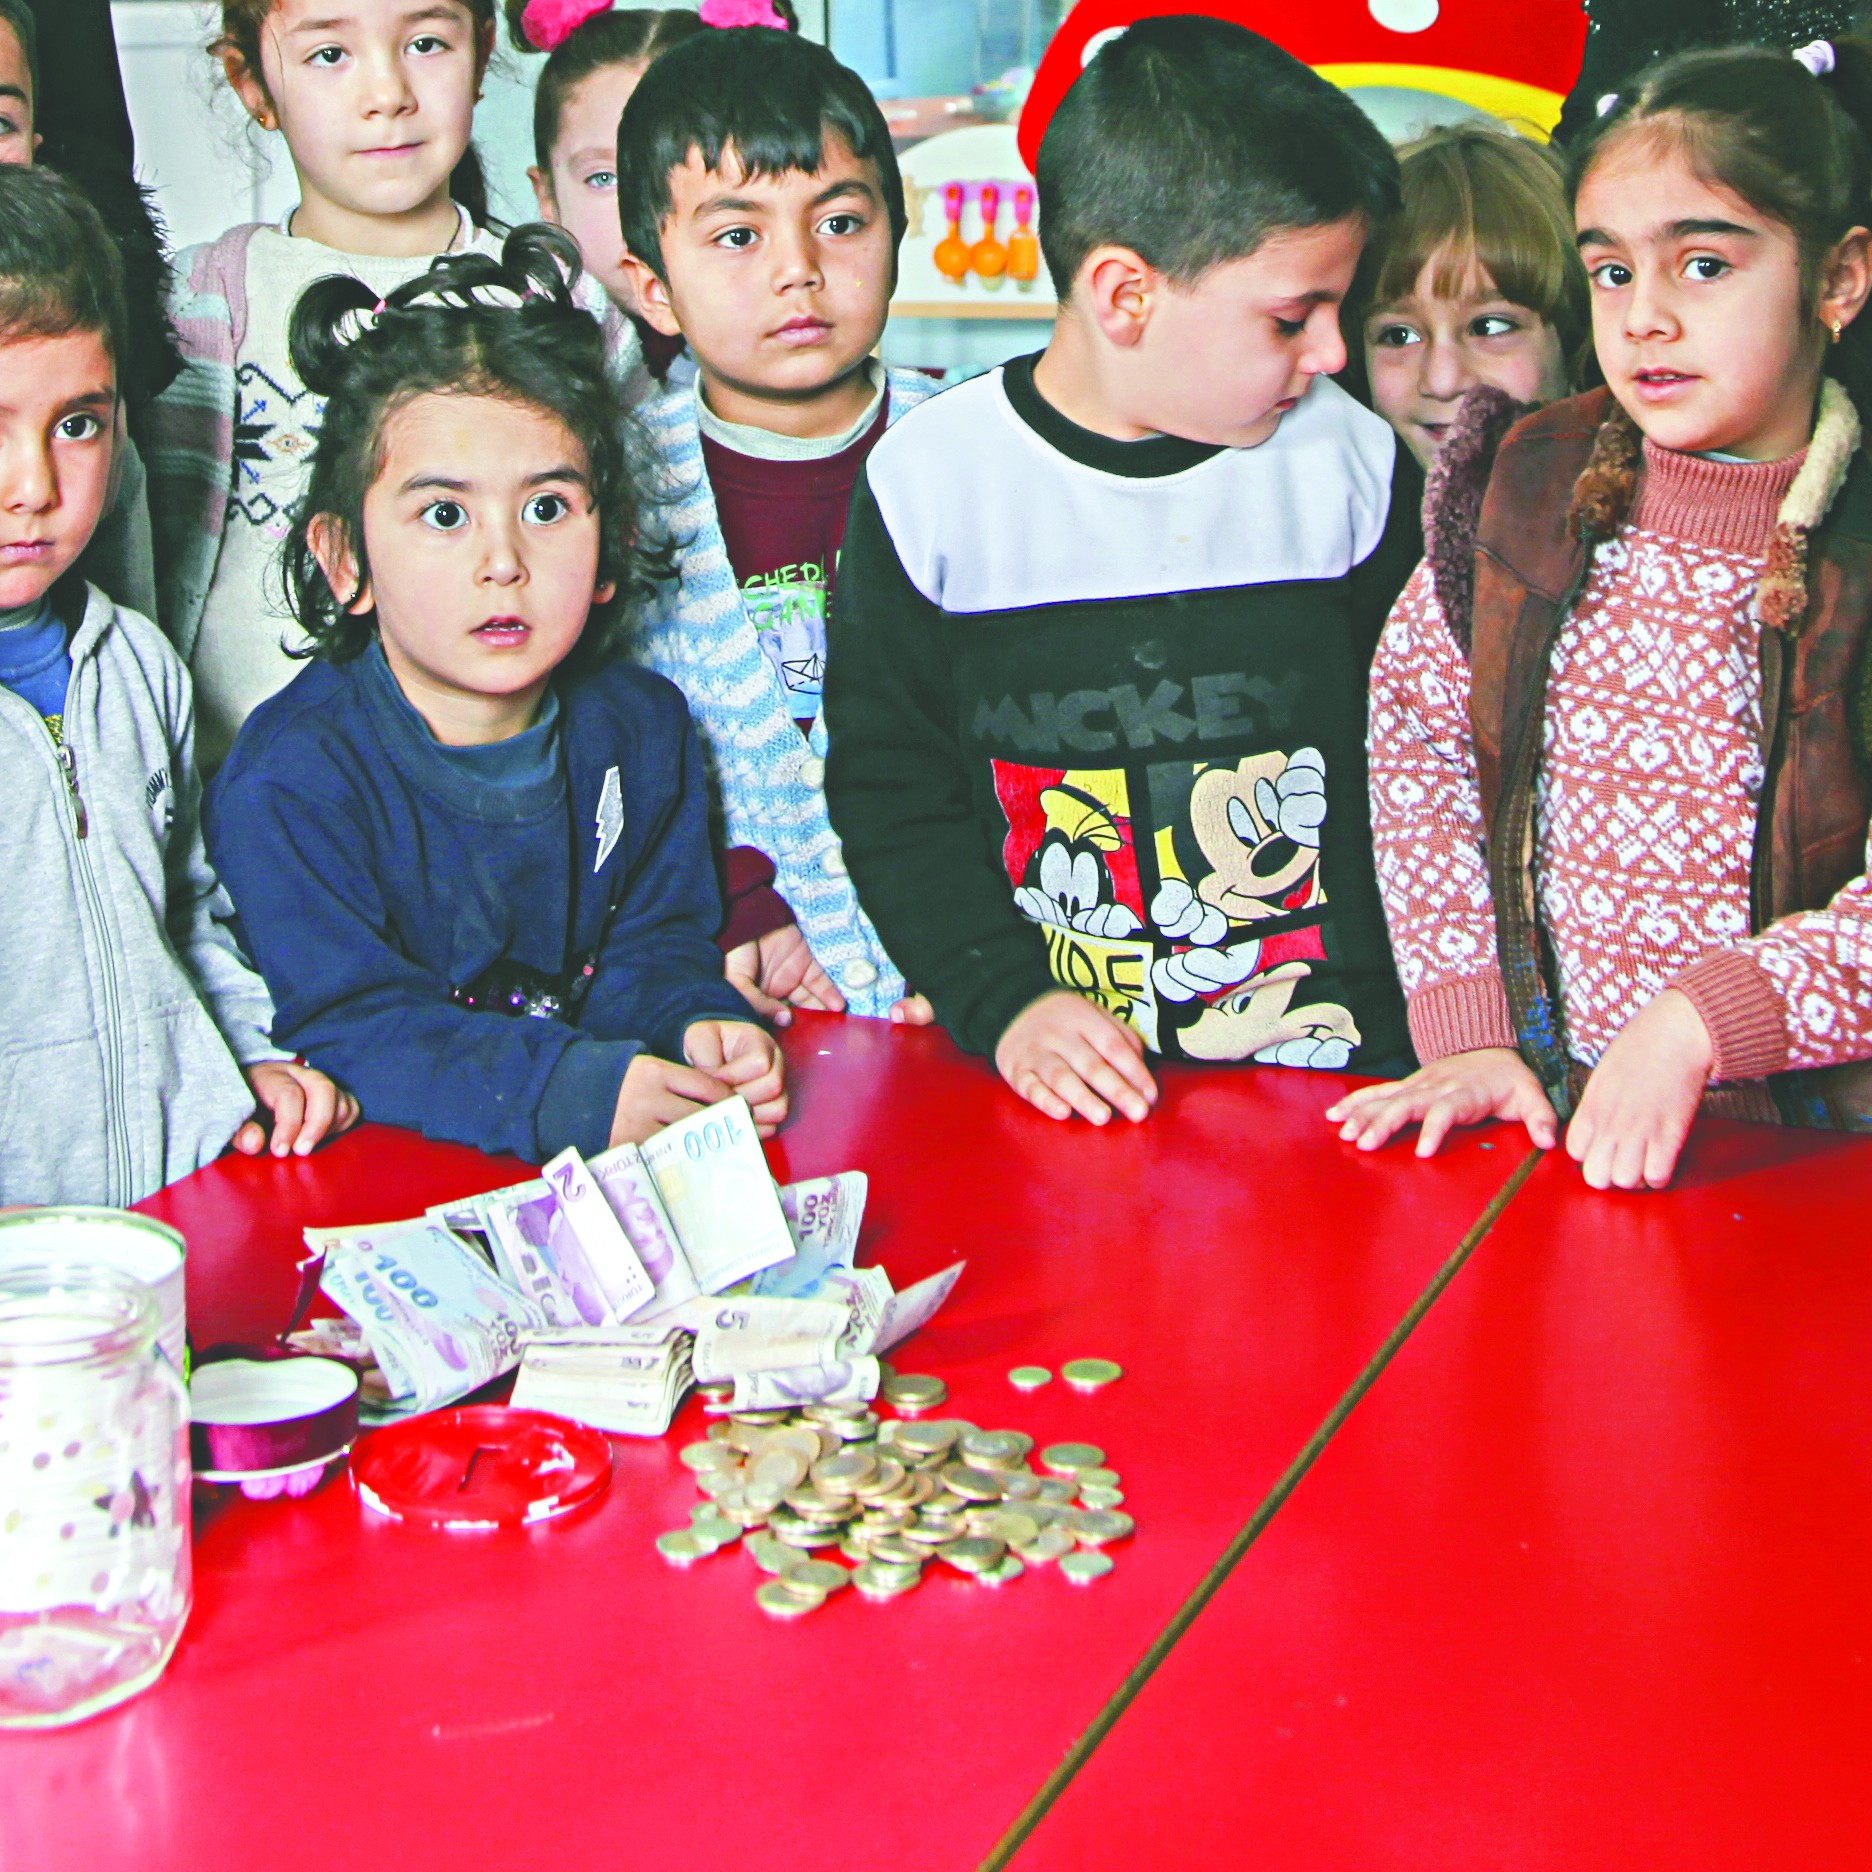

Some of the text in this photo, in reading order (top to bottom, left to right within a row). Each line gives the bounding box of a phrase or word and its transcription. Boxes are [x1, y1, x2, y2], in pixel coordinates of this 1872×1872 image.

[970, 671, 1304, 754] MICKEY
[684, 1114, 744, 1162] 100
[798, 1193, 818, 1243] 100
[374, 1253, 439, 1309] 100
